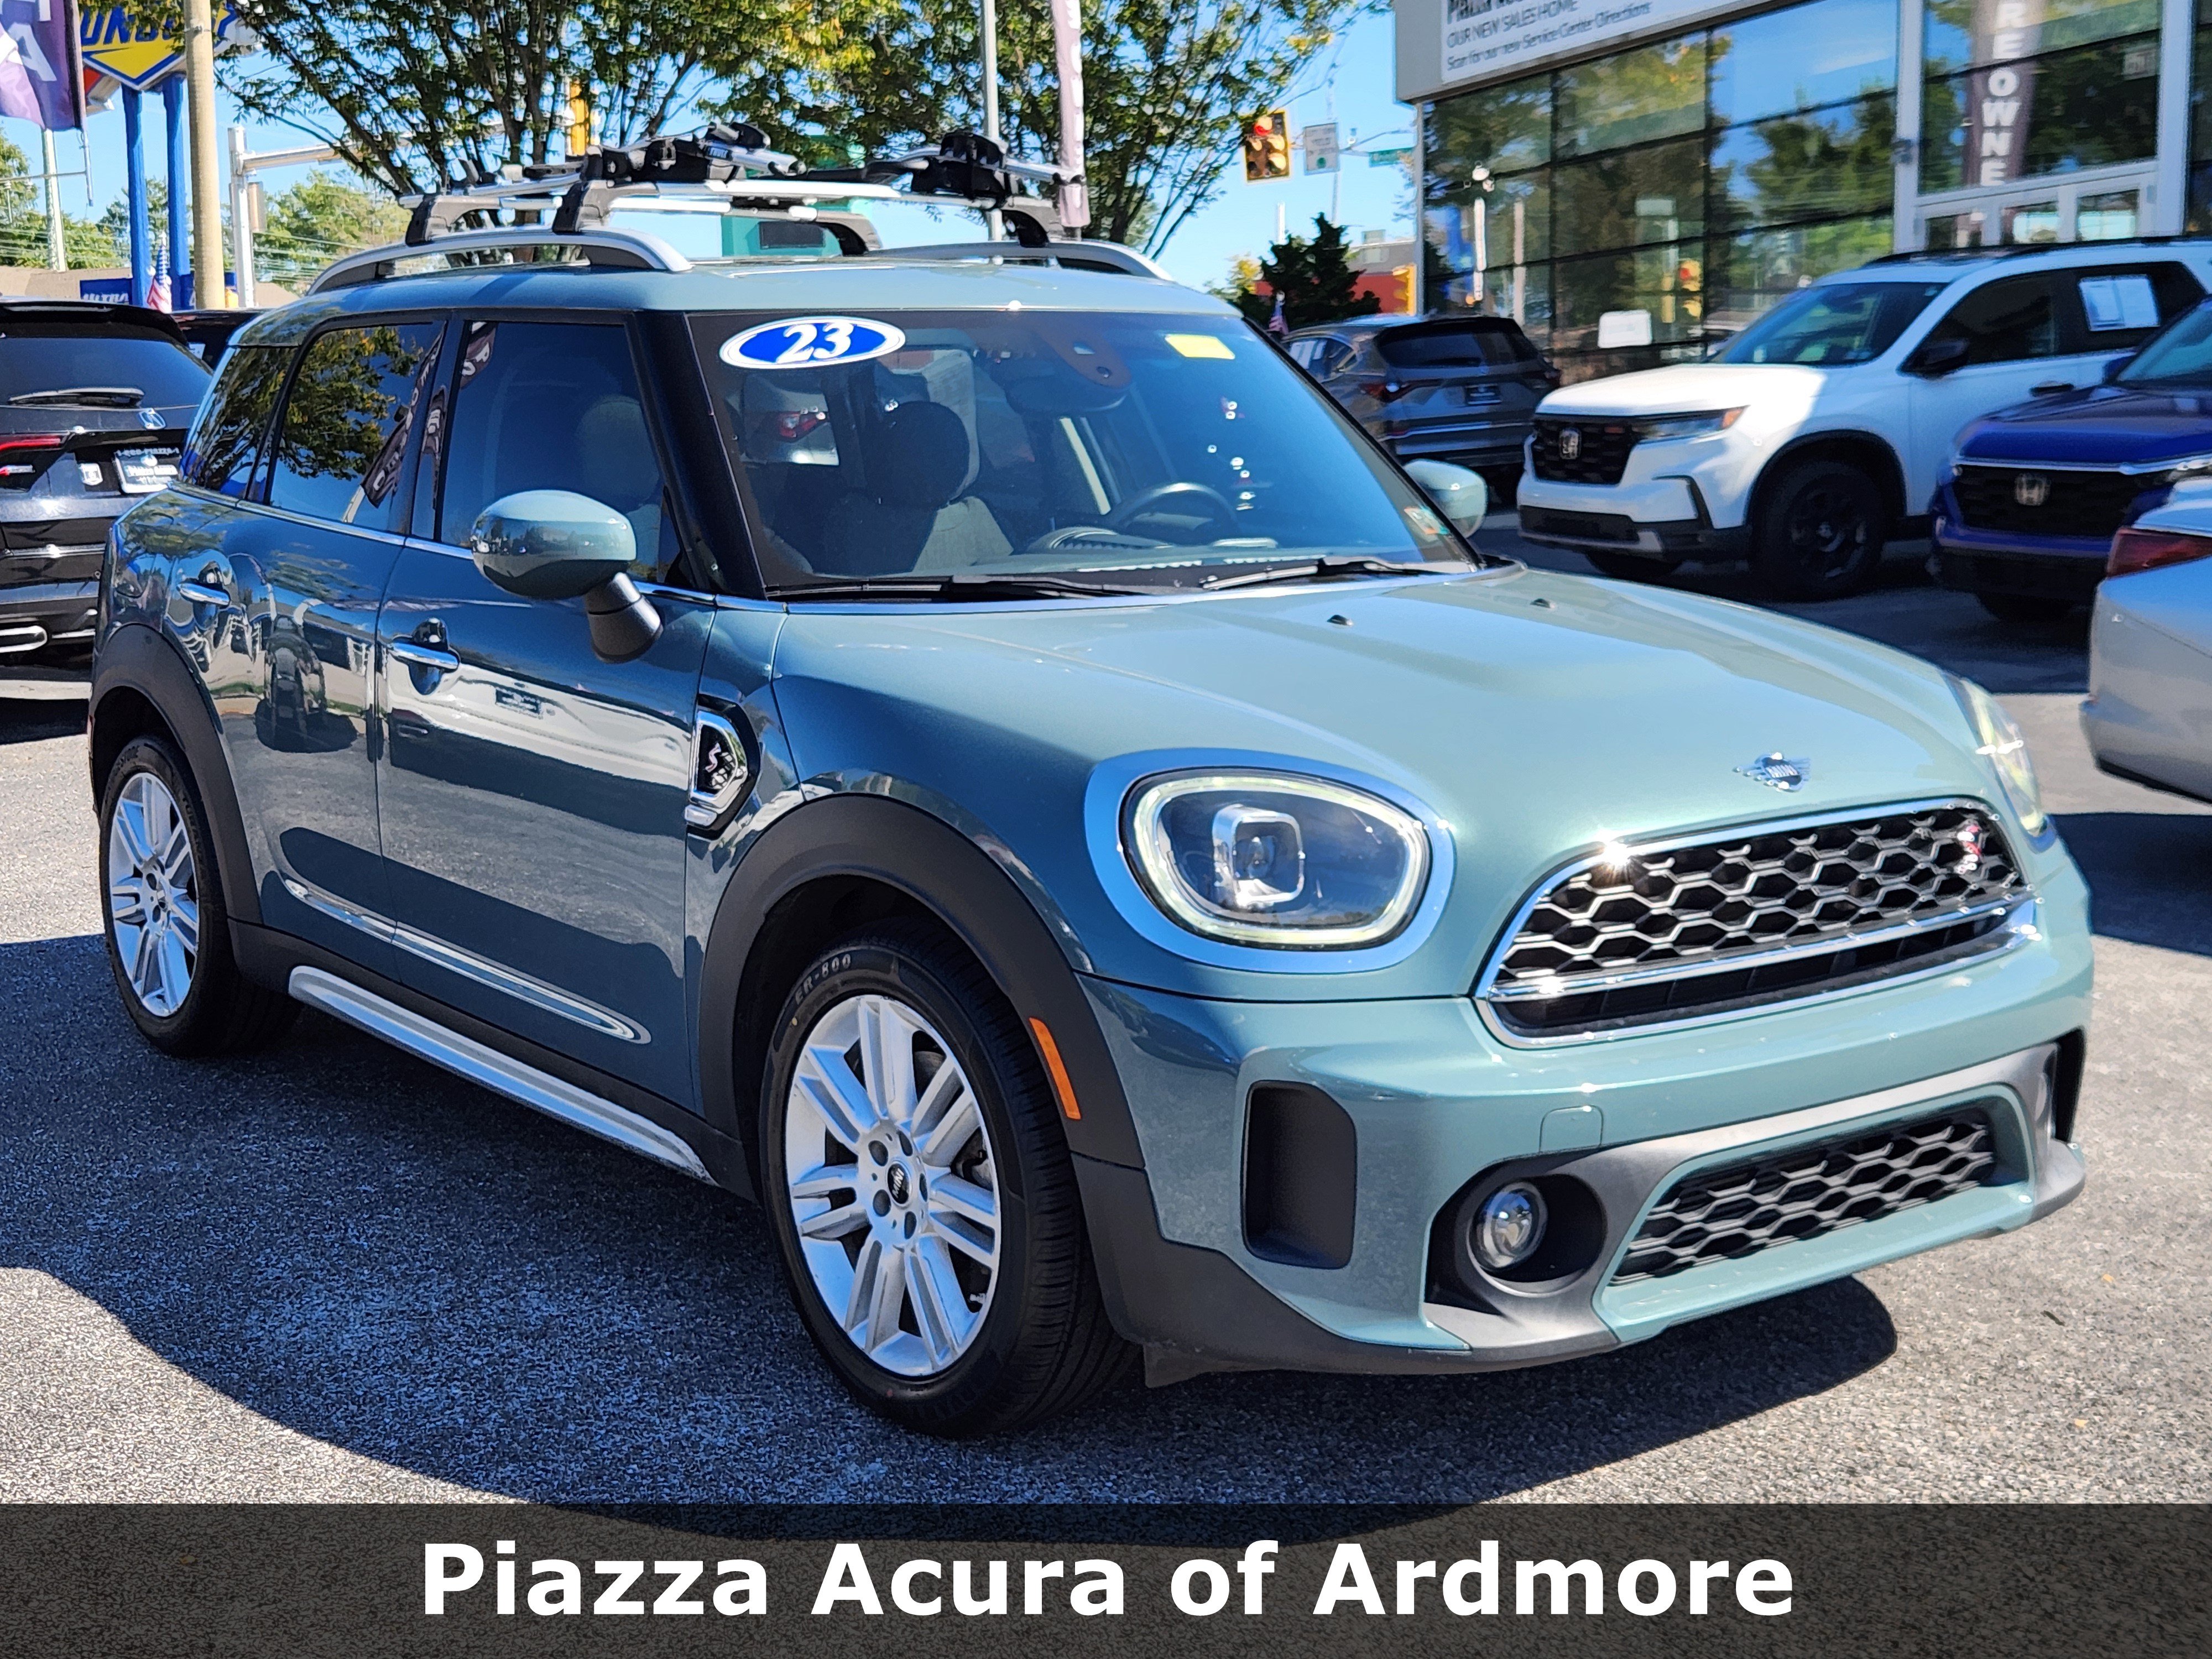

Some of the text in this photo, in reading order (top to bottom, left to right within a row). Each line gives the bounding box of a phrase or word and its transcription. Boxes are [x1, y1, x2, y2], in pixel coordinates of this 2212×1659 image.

[776, 322, 854, 364] 23
[795, 953, 851, 1005] ER-800
[891, 1167, 904, 1199] MINI
